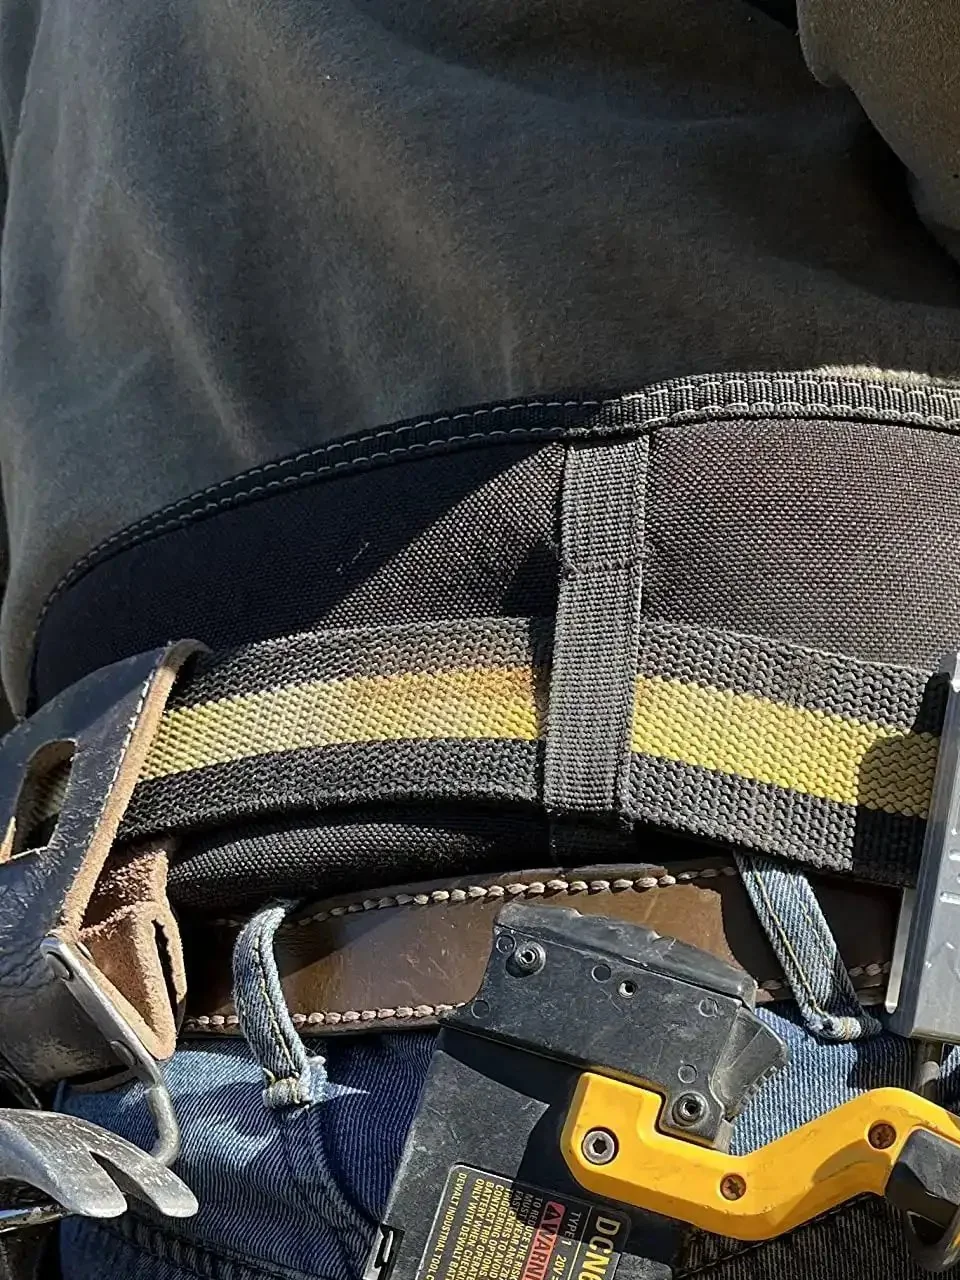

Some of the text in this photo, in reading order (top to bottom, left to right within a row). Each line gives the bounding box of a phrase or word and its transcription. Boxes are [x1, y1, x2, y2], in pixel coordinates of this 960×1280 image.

[448, 1172, 466, 1205] DEWALT
[470, 1178, 484, 1200] ONLY
[474, 1181, 493, 1218] BATTERY
[462, 1201, 476, 1224] WITH
[483, 1183, 503, 1223] CONTACT
[489, 1187, 512, 1238] TRIGGERING
[501, 1190, 523, 1238] FASTENERS
[518, 1193, 532, 1217] MUST
[433, 1205, 456, 1253] INDUSTRIAL
[477, 1224, 490, 1243] TRIP
[510, 1219, 524, 1245] WEAR
[521, 1208, 538, 1242] REDUCE
[563, 1210, 581, 1238] TYPE
[451, 1225, 469, 1260] DEWALT
[496, 1238, 507, 1251] TO
[427, 1253, 441, 1274] TOOL
[488, 1251, 503, 1278] AVOID
[502, 1245, 516, 1267] ANSI
[551, 1254, 566, 1275] 20V
[509, 1260, 522, 1280] RISK
